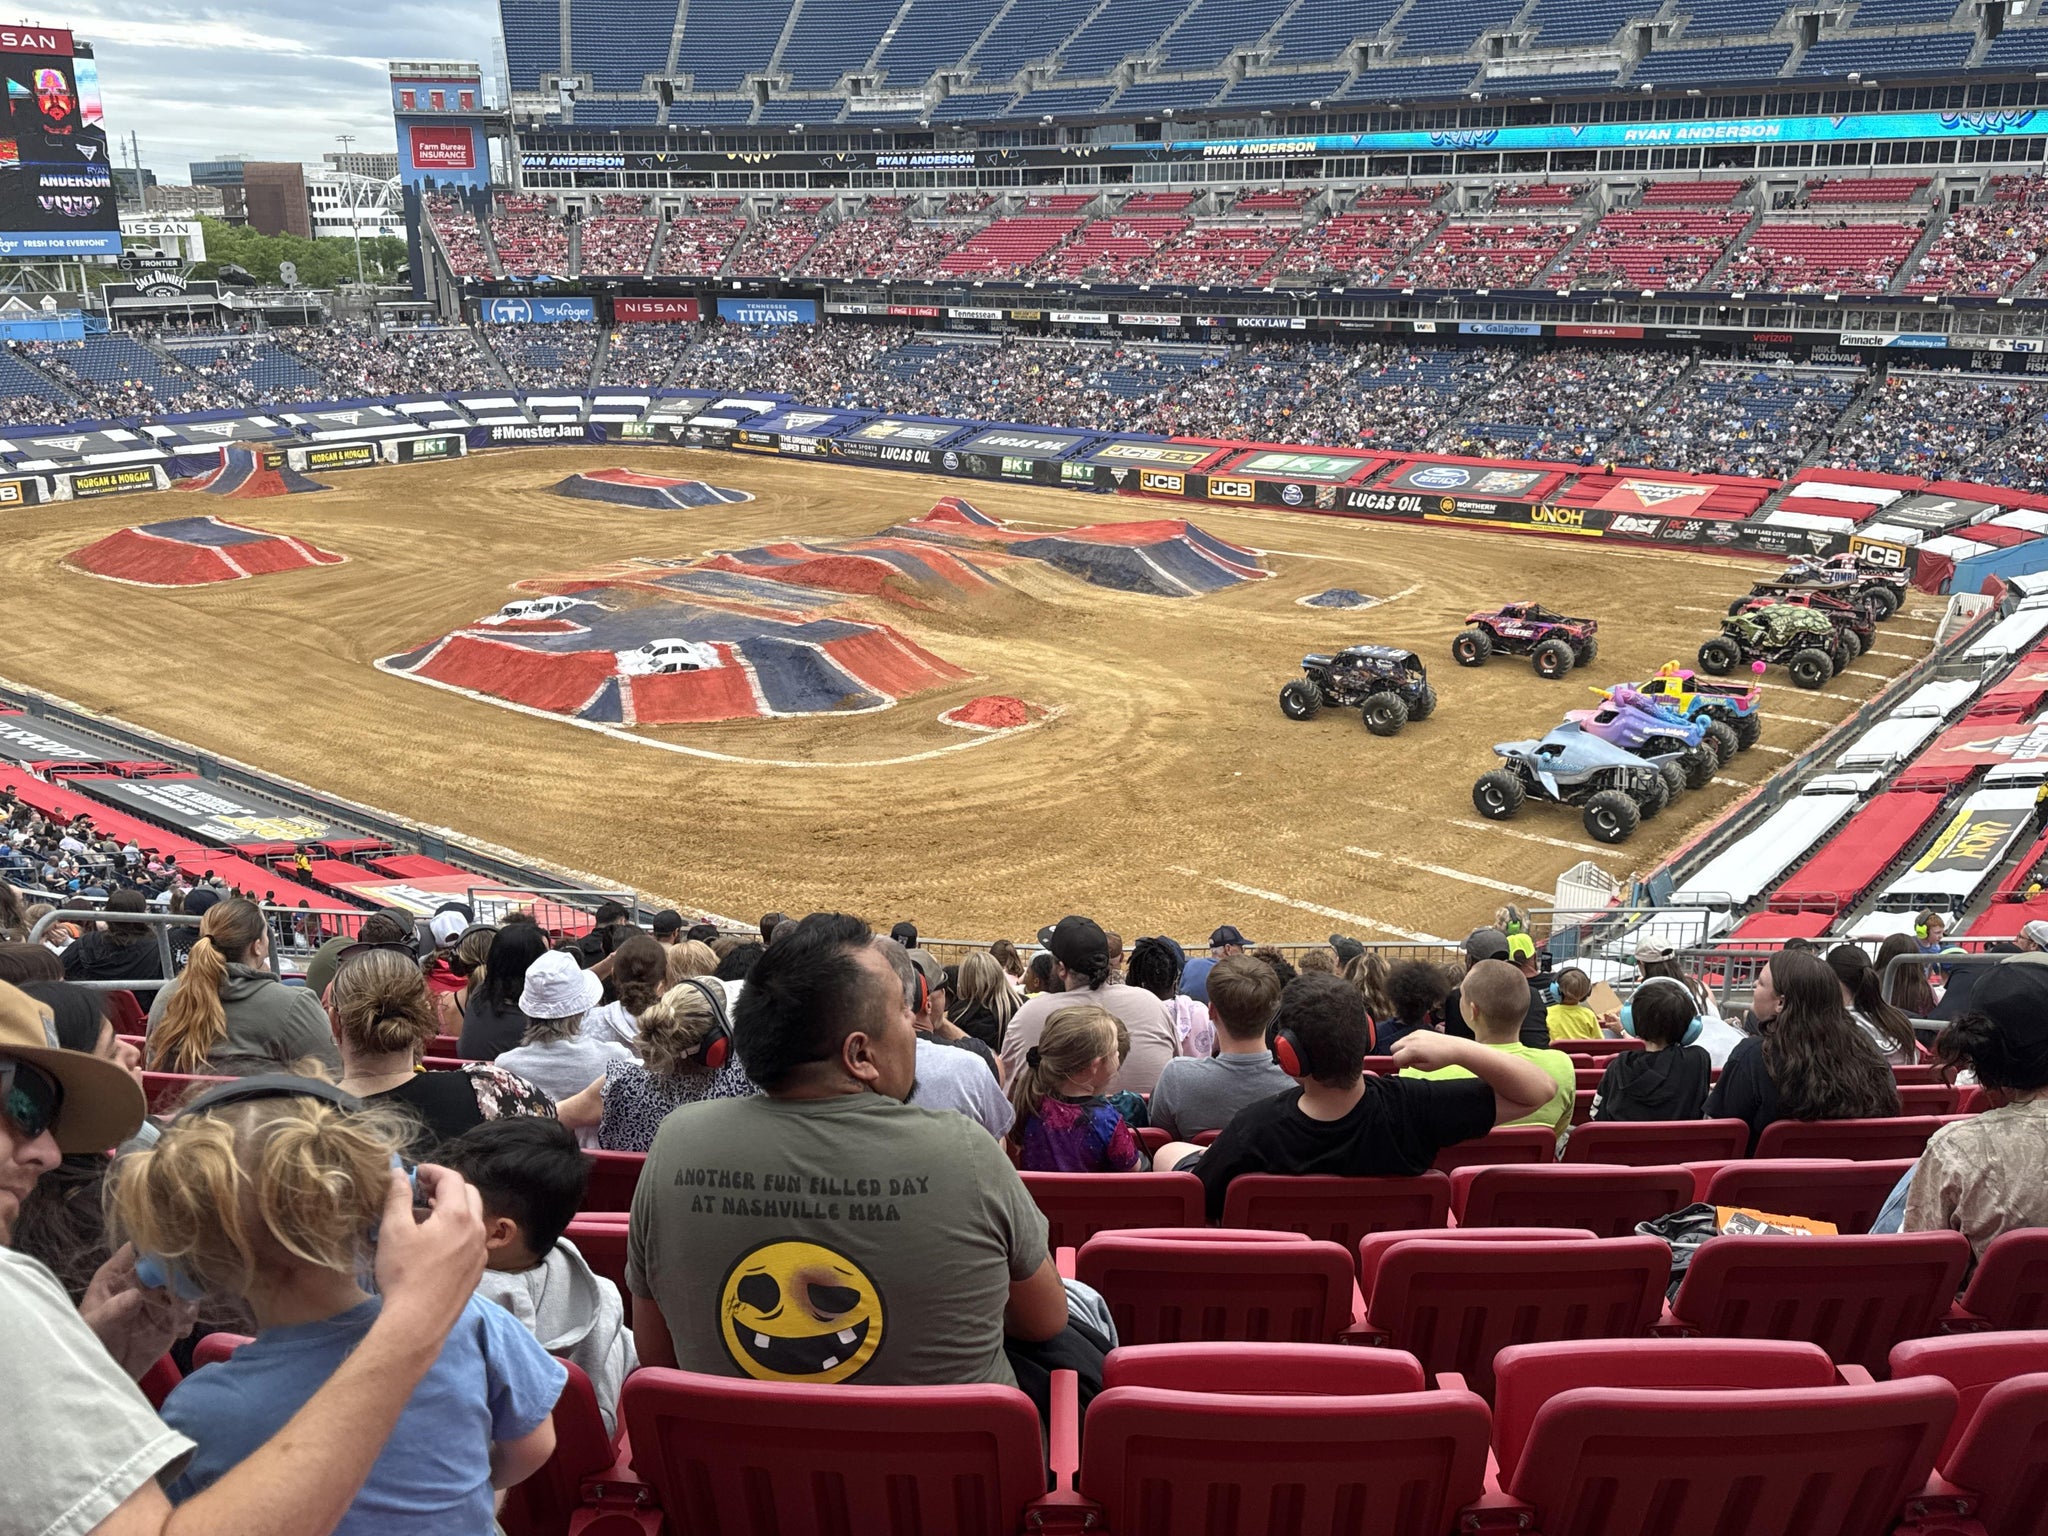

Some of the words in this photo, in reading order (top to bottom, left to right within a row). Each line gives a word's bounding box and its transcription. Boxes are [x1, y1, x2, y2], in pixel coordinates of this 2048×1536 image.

[1624, 128, 1671, 141] RYAN
[1675, 124, 1780, 139] ANDERSON
[419, 143, 439, 151] Farm
[440, 143, 466, 151] Bureau
[1203, 145, 1238, 156] RYAN
[1240, 141, 1317, 154] ANDERSON
[419, 151, 467, 159] INSURANCE
[549, 156, 625, 166] ANDERSON
[875, 156, 907, 166] RYAN
[909, 154, 976, 165] ANDERSON
[120, 223, 189, 235] NISSAN
[23, 239, 47, 247] FRESH
[49, 239, 64, 247] FOR
[140, 259, 178, 267] FRONTIER
[134, 275, 154, 292] JACK
[153, 269, 188, 292] DANIEL'S
[555, 303, 590, 321] Kroger
[625, 303, 688, 313] NISSAN
[737, 309, 799, 322] TITANS
[1237, 317, 1268, 328] ROCKY
[1269, 318, 1288, 328] LAW
[1485, 324, 1529, 334] Gallagher
[1752, 333, 1793, 343] verizon
[1841, 334, 1883, 346] Pinnacle
[1811, 345, 1836, 353] MIKE
[2009, 339, 2037, 351] tsu
[492, 424, 584, 440] #MonsterJam
[622, 422, 655, 435] BKT
[780, 435, 792, 443] THE
[413, 440, 446, 454] BKT
[780, 443, 800, 452] SUPER
[800, 445, 816, 454] GLUE
[858, 444, 878, 452] SPORTS
[1107, 445, 1161, 459] JCB
[311, 452, 338, 464] MORGAN
[338, 450, 344, 460] &
[344, 448, 370, 459] MORGAN
[880, 446, 912, 462] LUCAS
[914, 450, 931, 464] OIL
[1001, 457, 1033, 473] BKT
[1061, 463, 1095, 479] BKT
[77, 475, 110, 489] MORGAN
[110, 475, 118, 485] &
[118, 471, 150, 485] MORGAN
[1144, 475, 1182, 490] JCB
[1211, 482, 1252, 497] JCB
[1347, 491, 1395, 511] LUCAS
[1398, 496, 1423, 513] OIL
[1456, 501, 1498, 510] NORTHERN
[1531, 505, 1584, 525] UNOH
[1667, 520, 1685, 530] RC
[1662, 529, 1698, 540] CARS
[1772, 530, 1786, 538] CITY,
[1853, 543, 1901, 565] JCB
[1503, 628, 1534, 638] SIDE
[674, 1167, 756, 1190] ANOTHER
[763, 1174, 801, 1193] FUN
[809, 1175, 882, 1197] FILLED
[889, 1175, 930, 1197] DAY
[691, 1194, 716, 1214] AT
[721, 1195, 840, 1220] NASHVILLE
[848, 1203, 901, 1222] MMA
